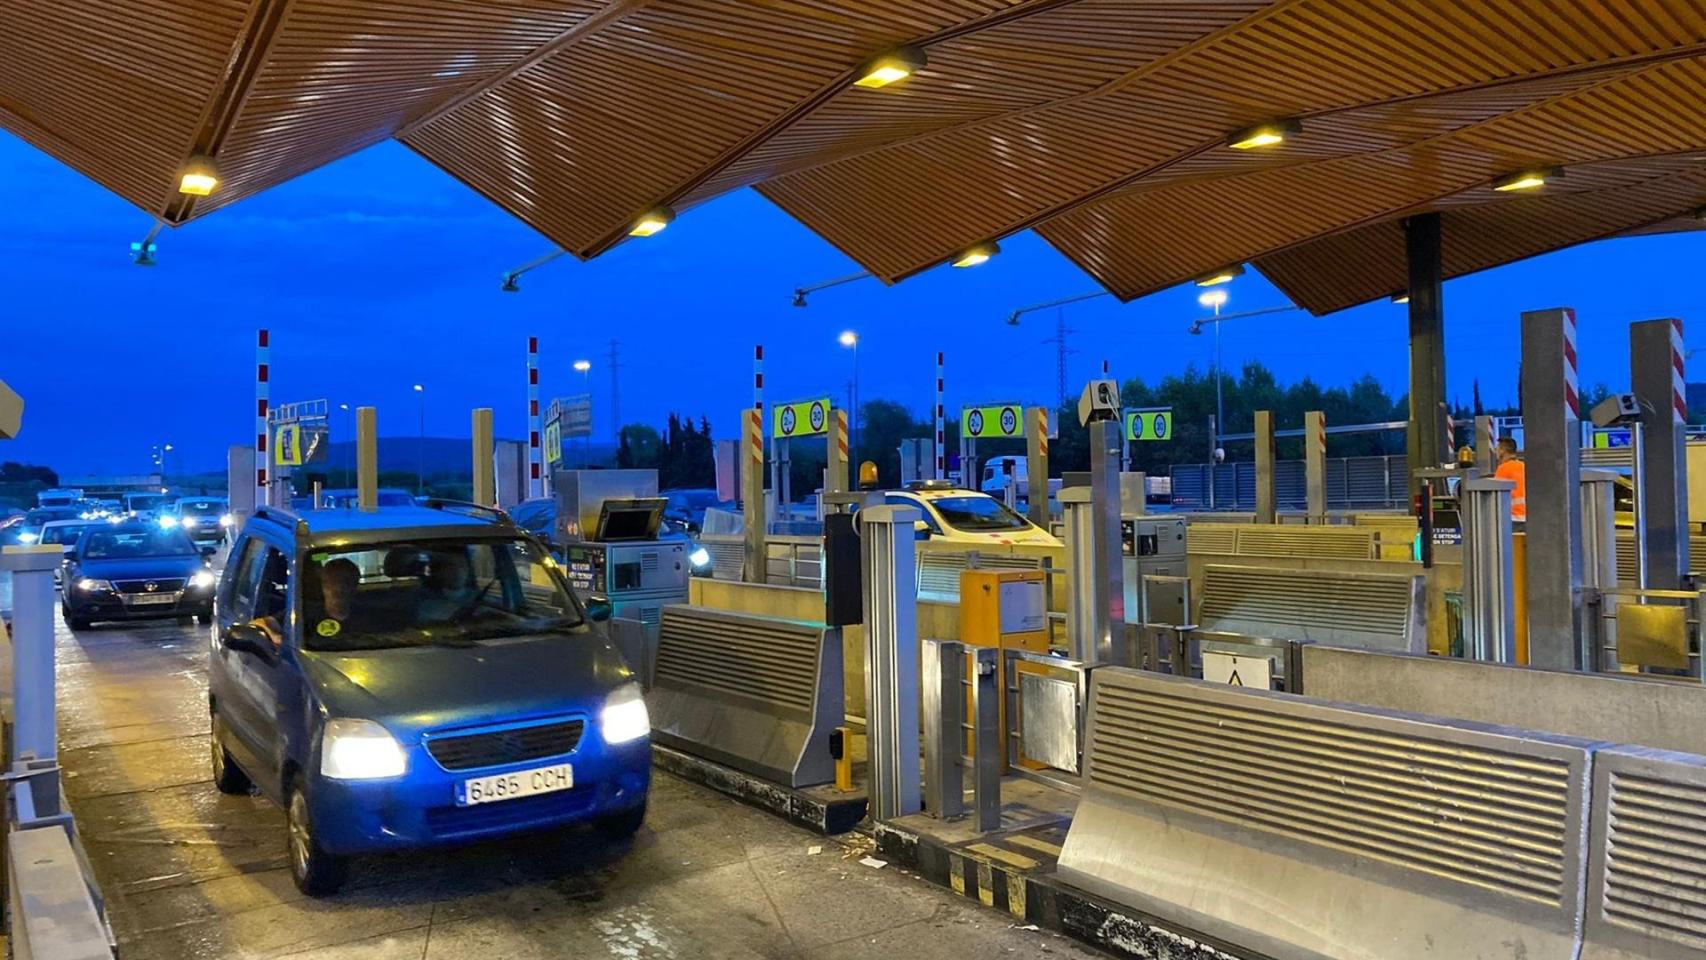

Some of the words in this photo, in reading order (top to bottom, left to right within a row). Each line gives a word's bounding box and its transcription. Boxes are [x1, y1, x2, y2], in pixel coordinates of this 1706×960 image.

[1003, 415, 1014, 425] 30
[470, 775, 519, 801] 6485
[530, 767, 568, 790] CCH
